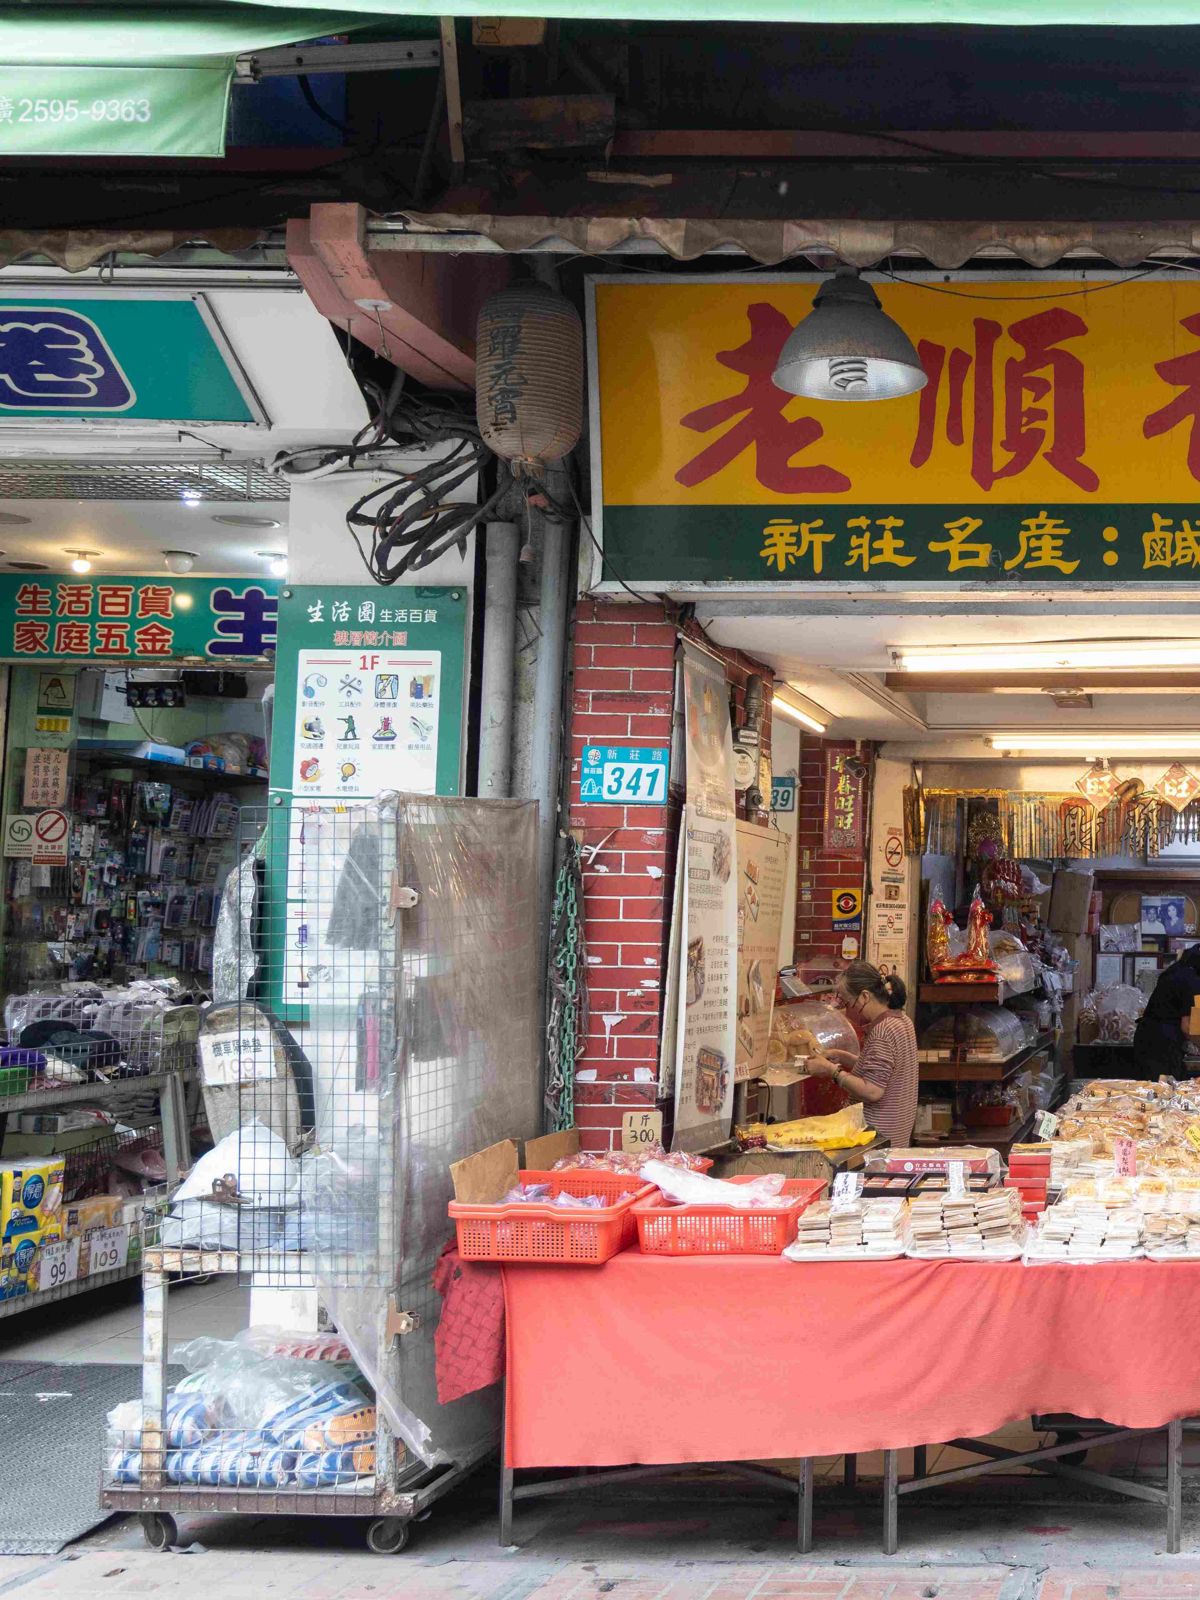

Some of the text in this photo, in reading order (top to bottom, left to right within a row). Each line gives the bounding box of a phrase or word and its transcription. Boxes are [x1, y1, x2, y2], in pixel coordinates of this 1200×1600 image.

[18, 98, 151, 123] 2595-9363
[16, 583, 174, 619] 生活百貨
[306, 599, 438, 623] 生活圈 生活百貨
[14, 621, 174, 656] 家庭五金
[359, 655, 380, 671] 1F
[607, 749, 663, 760] 新莊路
[607, 767, 660, 796] 341
[629, 1129, 654, 1143] 300
[23, 1181, 43, 1199] 得意
[93, 1249, 119, 1270] 109
[50, 1261, 67, 1286] 99
